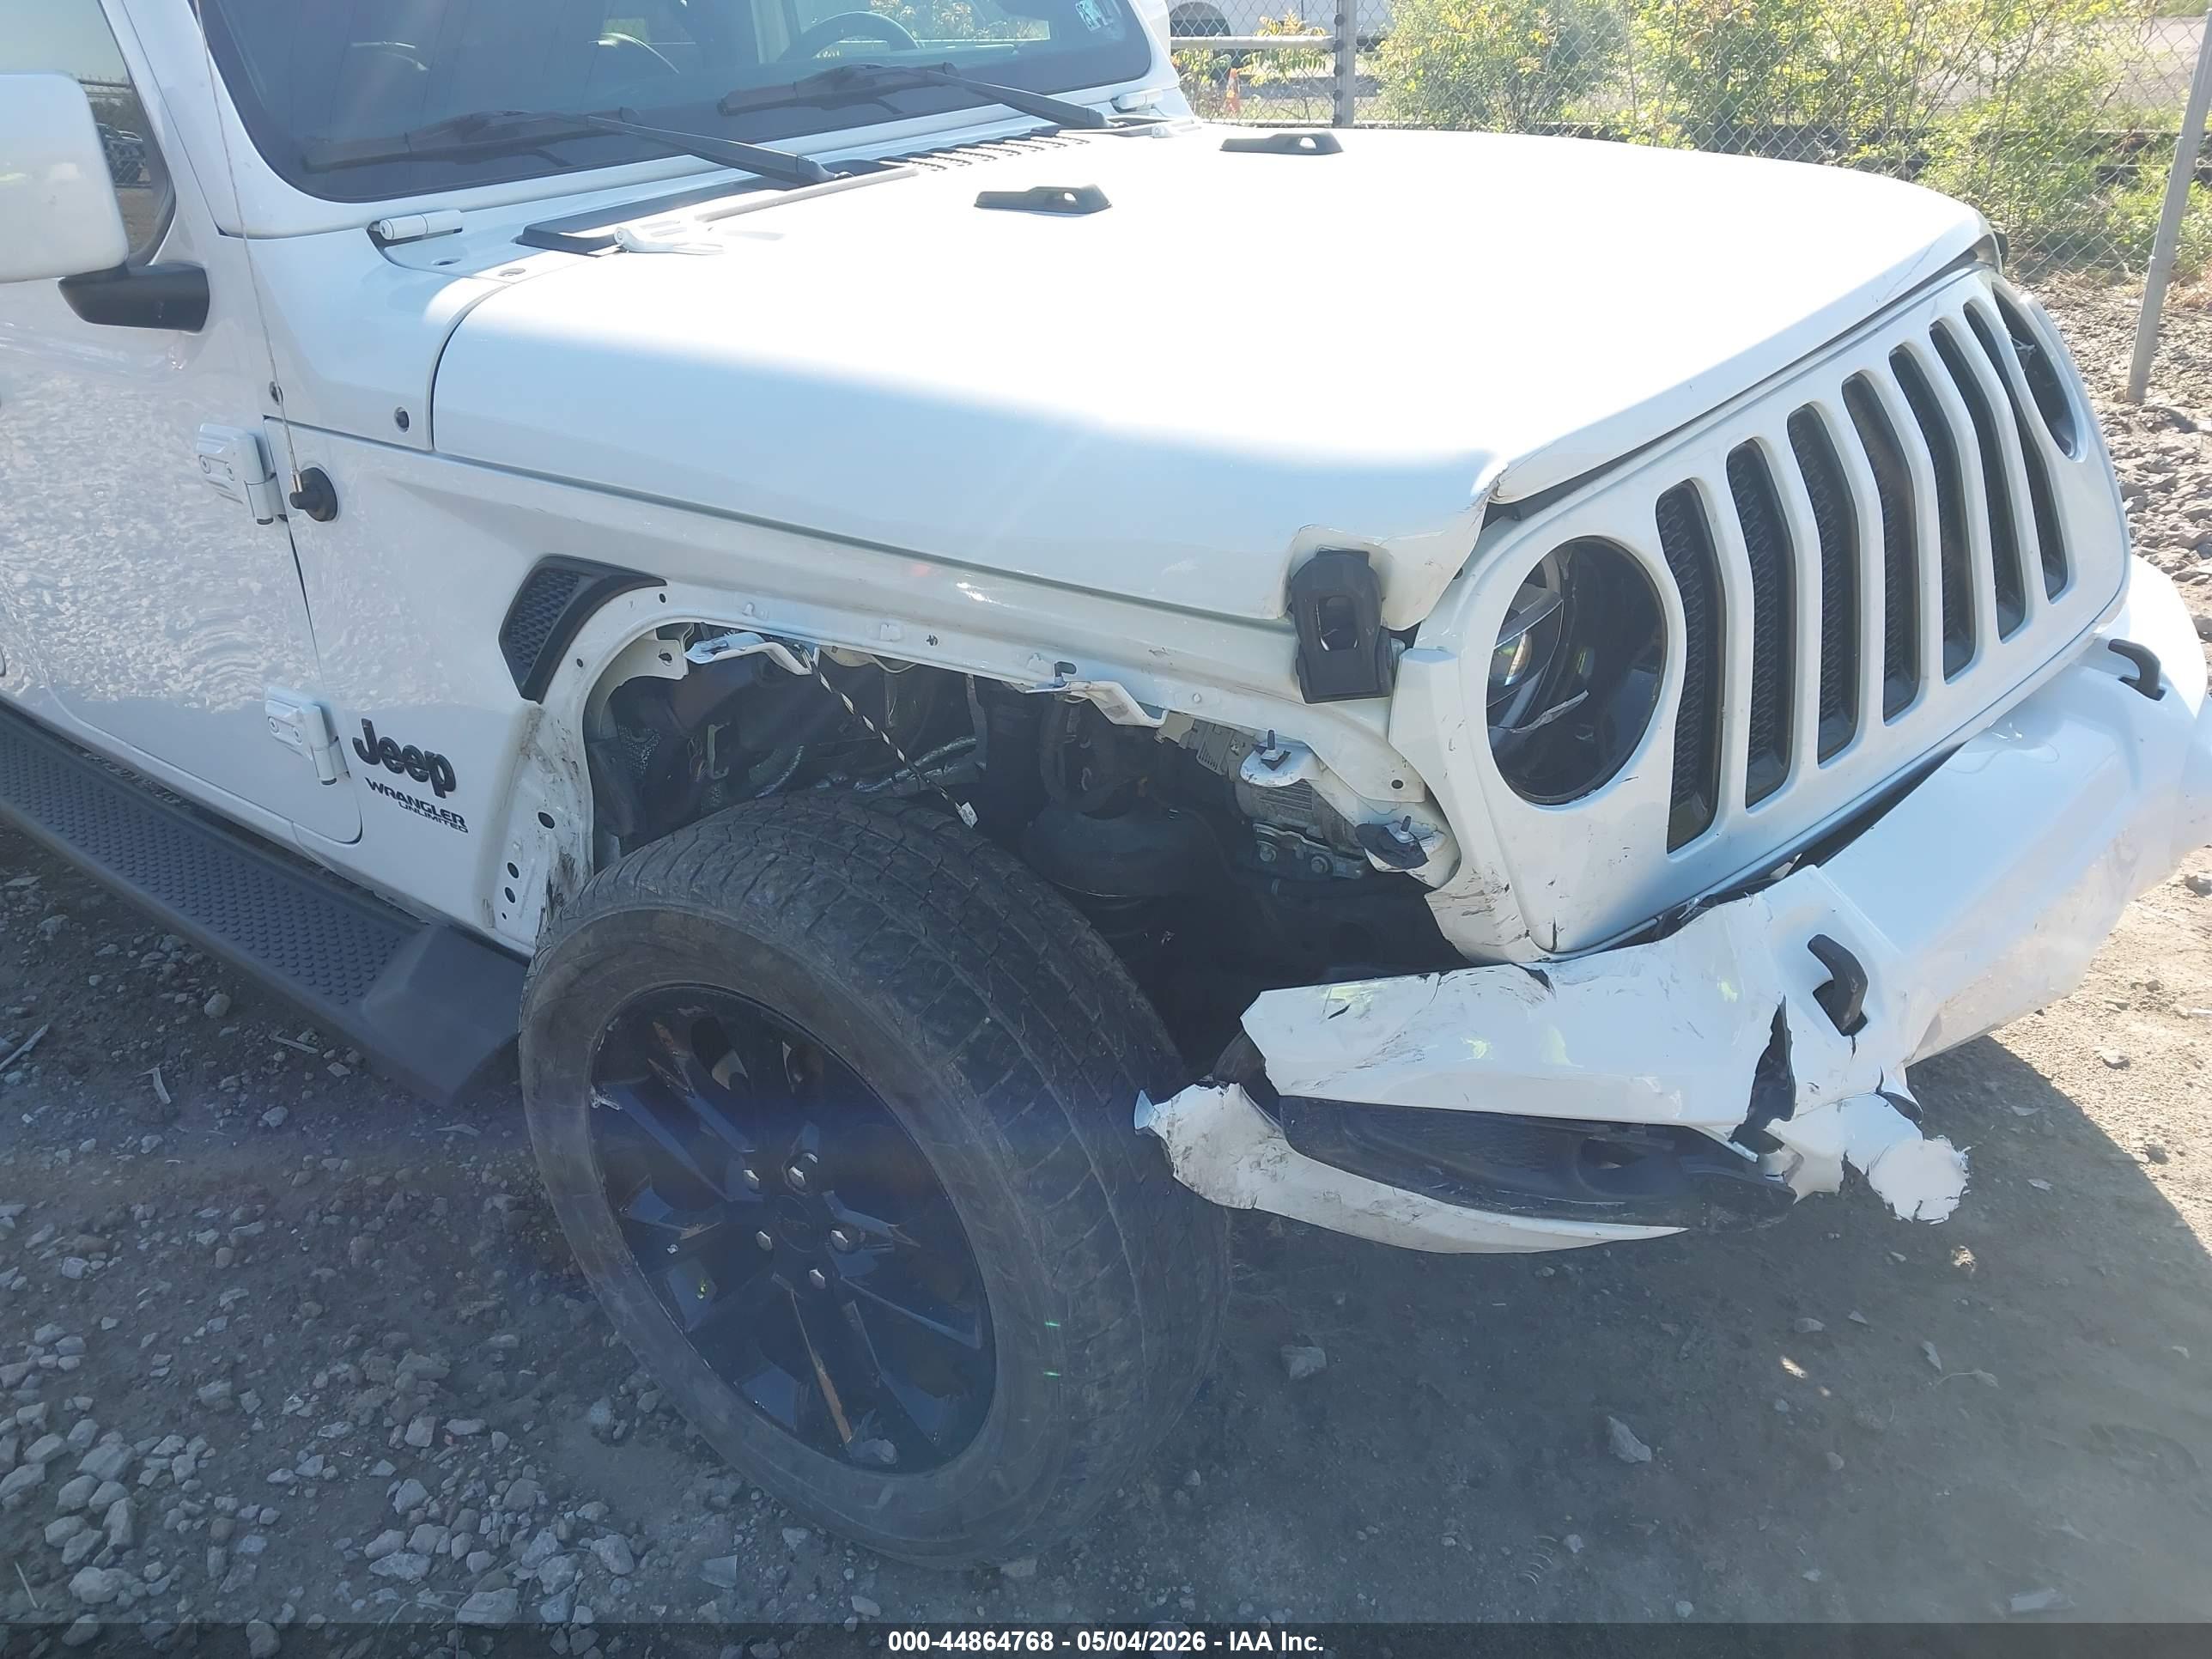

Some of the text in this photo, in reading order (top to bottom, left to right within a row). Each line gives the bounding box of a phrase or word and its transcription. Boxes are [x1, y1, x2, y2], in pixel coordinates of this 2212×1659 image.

[352, 718, 457, 799] Jeep
[365, 776, 467, 828] WRANGLER
[398, 800, 469, 834] UNLIMITED
